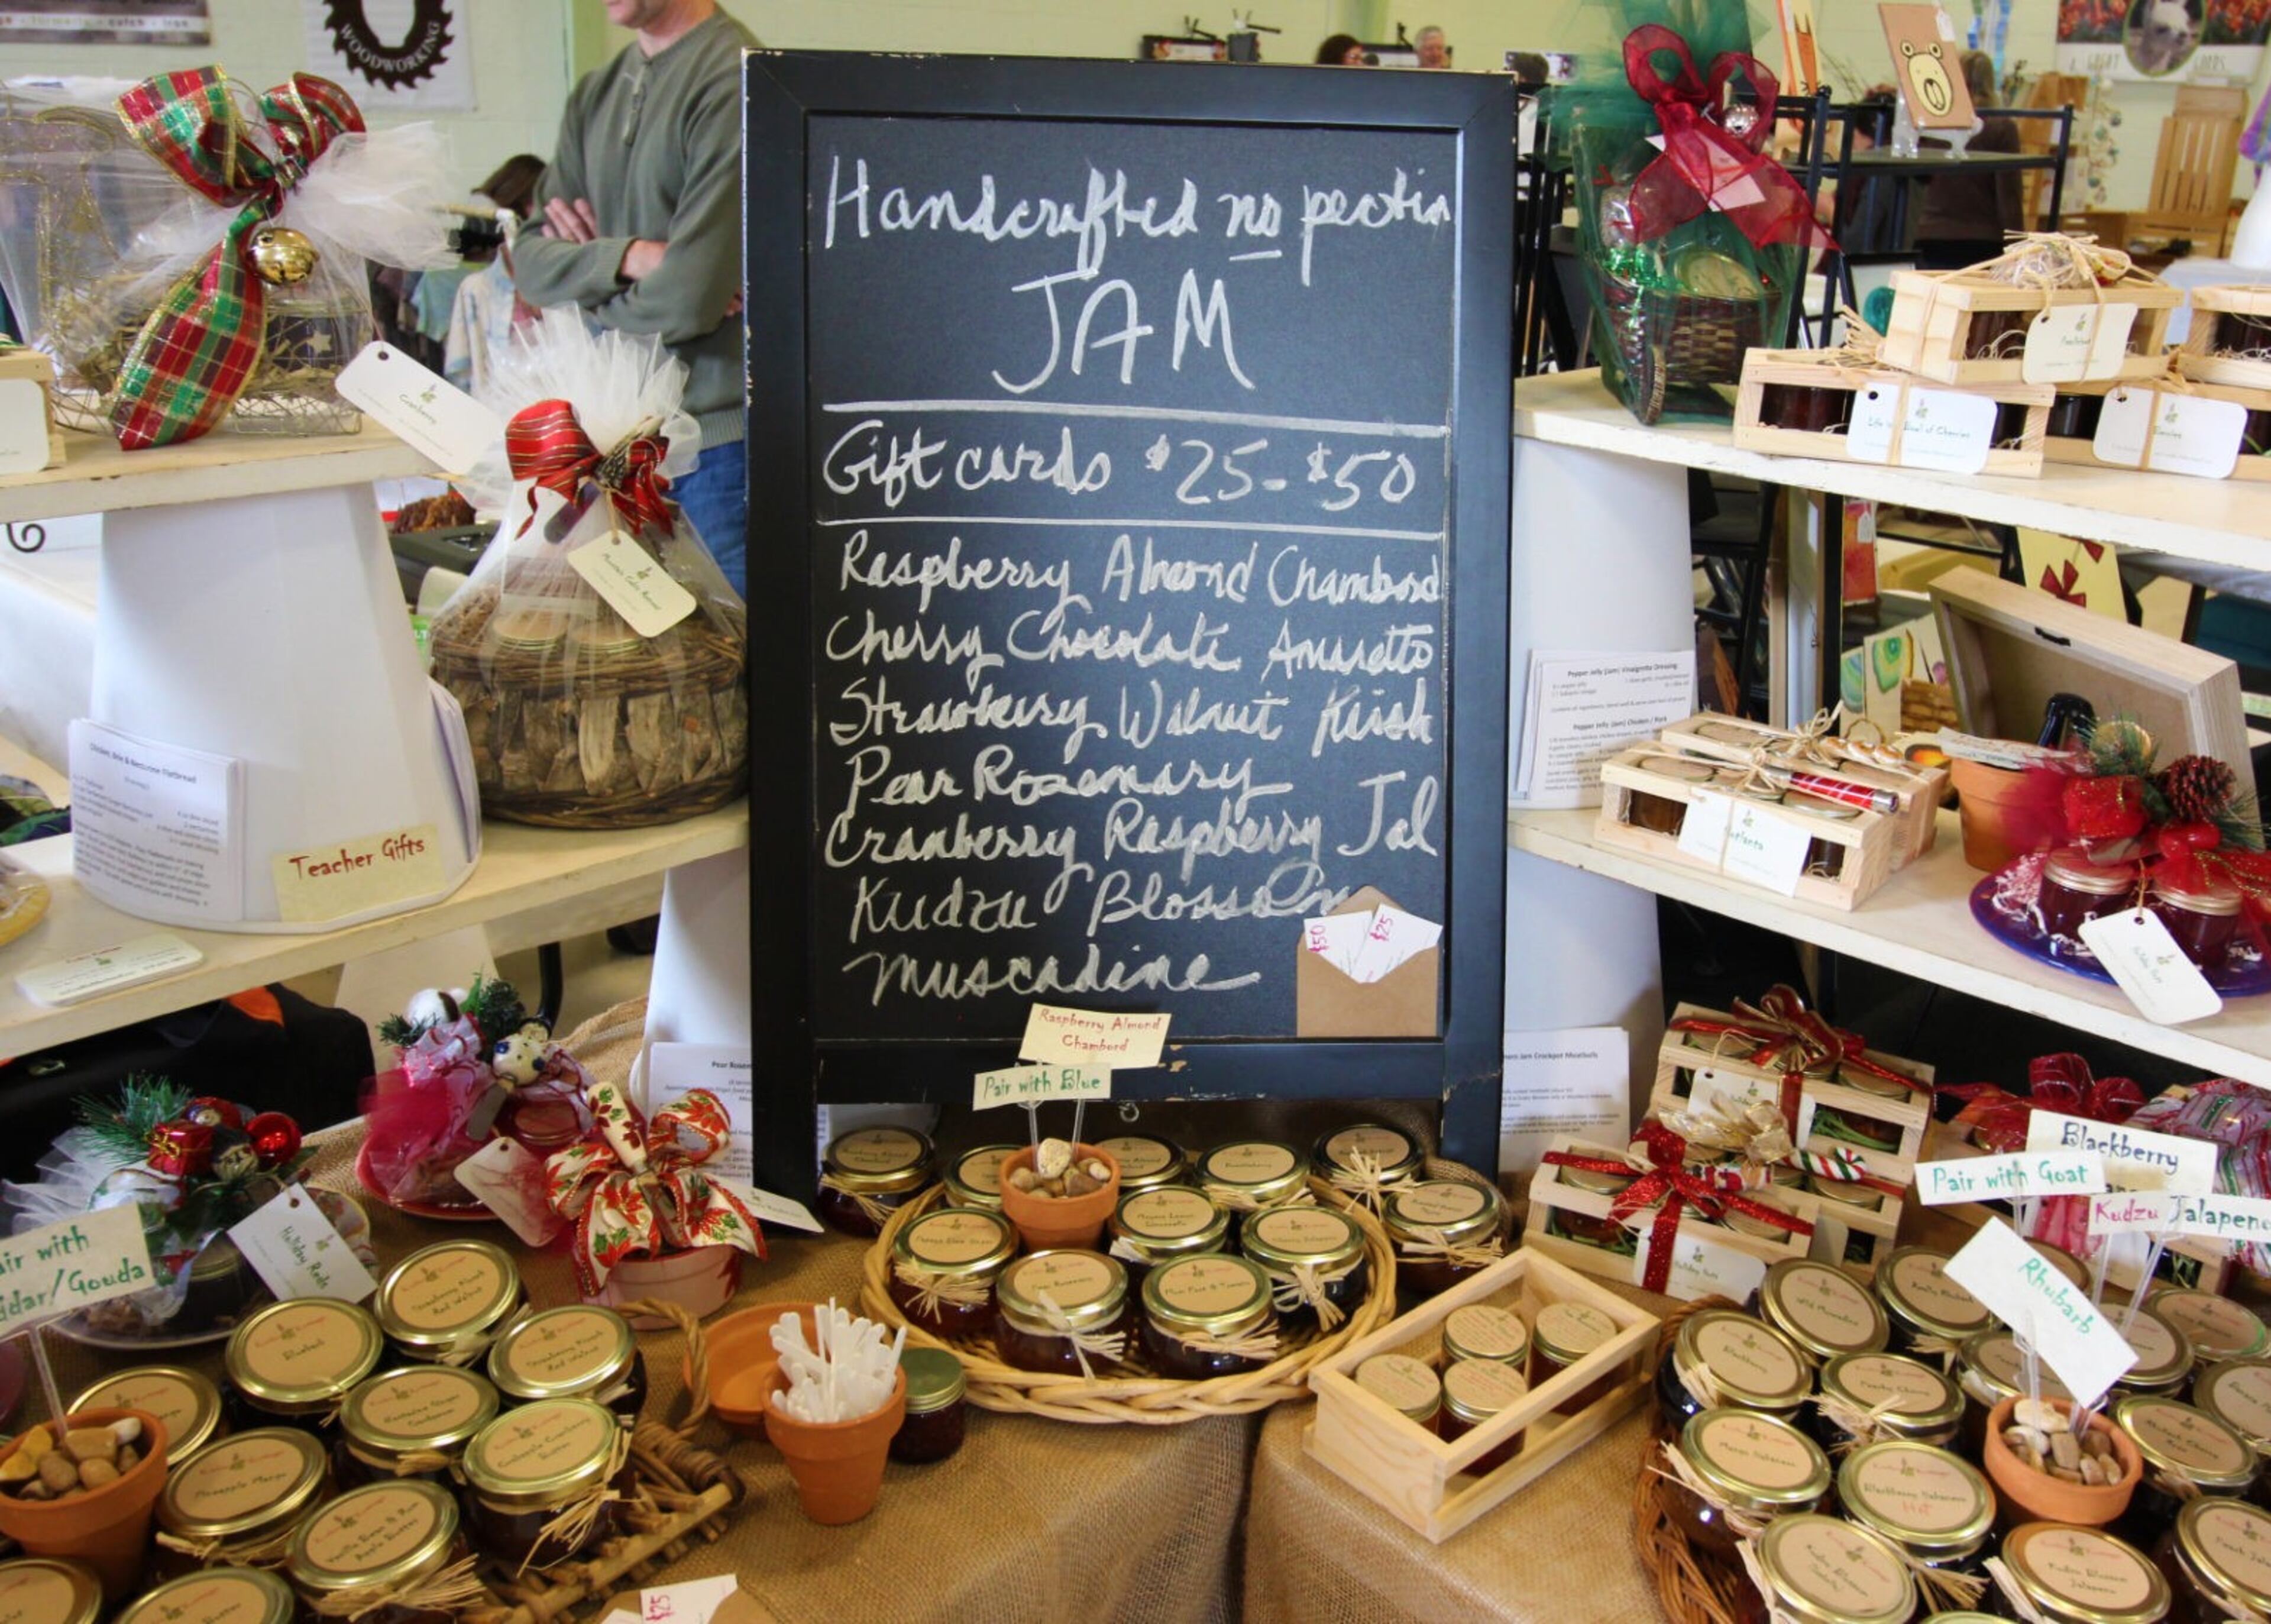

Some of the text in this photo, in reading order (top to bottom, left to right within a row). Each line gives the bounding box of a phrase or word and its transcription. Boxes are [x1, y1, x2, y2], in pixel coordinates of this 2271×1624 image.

[339, 21, 440, 72] WOODWORKING
[826, 156, 1451, 286] Handcrafted no pectin
[992, 269, 1255, 394] JAM
[823, 420, 946, 509] Gift
[956, 427, 1111, 494] cards
[1306, 443, 1416, 512] $50
[840, 530, 1444, 634] Raspberry Almond Chambord
[826, 609, 1004, 693] Cherry
[1007, 609, 1242, 672] Chocolate
[829, 675, 1108, 762] Strawberry
[846, 744, 1293, 819] Pear Rosemary
[289, 833, 425, 880] Teacher Gifts
[824, 812, 1093, 914] Cranberry
[850, 876, 1037, 943] Kudzu
[1308, 914, 1393, 953] $50 $25
[1039, 1008, 1163, 1033] Raspberry Almond
[1062, 1034, 1130, 1052] Chambord
[984, 1069, 1101, 1100] Pair with Blue
[1933, 1161, 2089, 1194] Pair with Goat
[2061, 1121, 2179, 1176] Blackberry
[2094, 1199, 2160, 1222] Kudzu
[37, 1224, 89, 1261] with
[2018, 1256, 2095, 1335] Rhubarb
